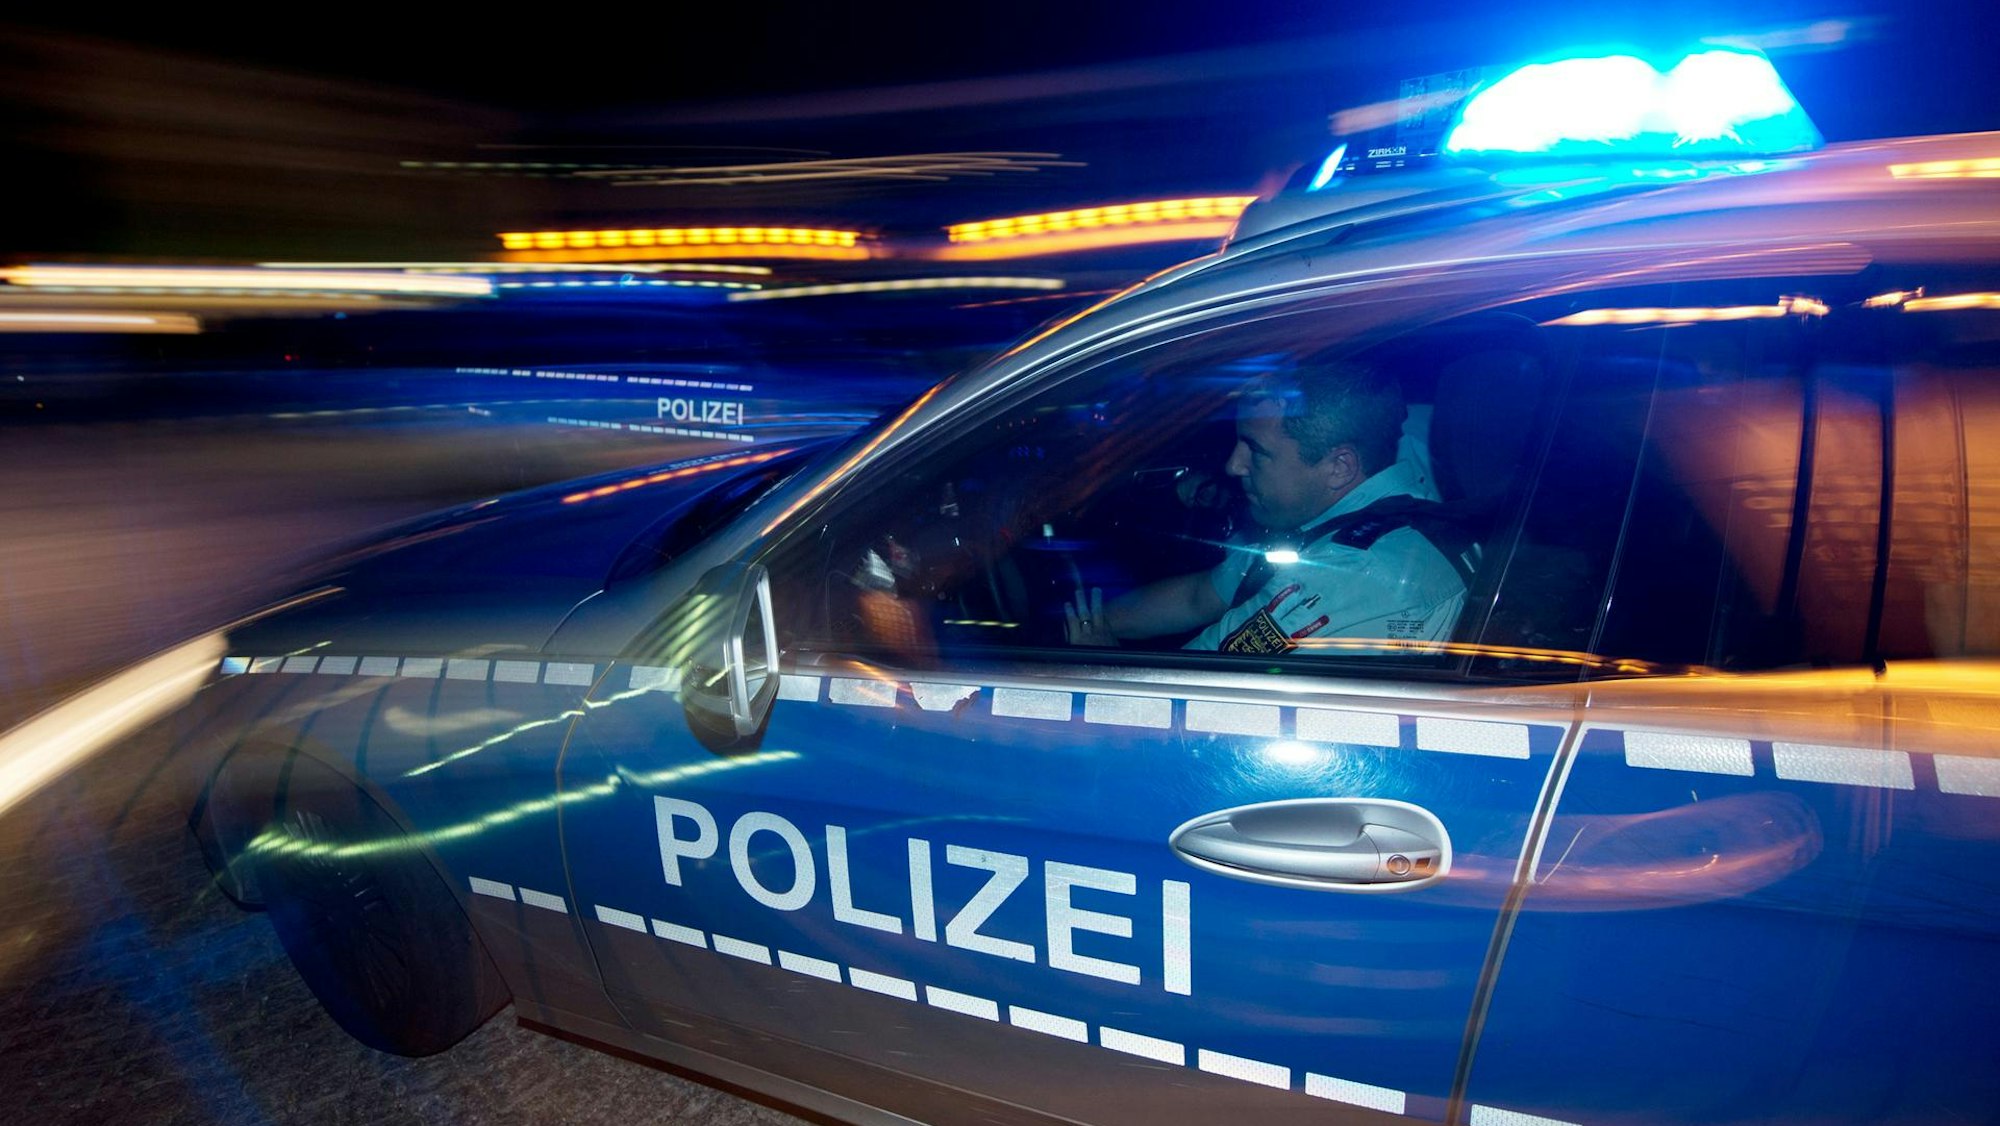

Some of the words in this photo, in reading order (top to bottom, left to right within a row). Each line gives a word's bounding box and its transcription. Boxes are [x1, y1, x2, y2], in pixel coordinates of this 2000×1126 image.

[657, 397, 744, 425] POLIZEI
[1257, 615, 1283, 650] POLIZEI
[654, 795, 1192, 996] POLIZEI
